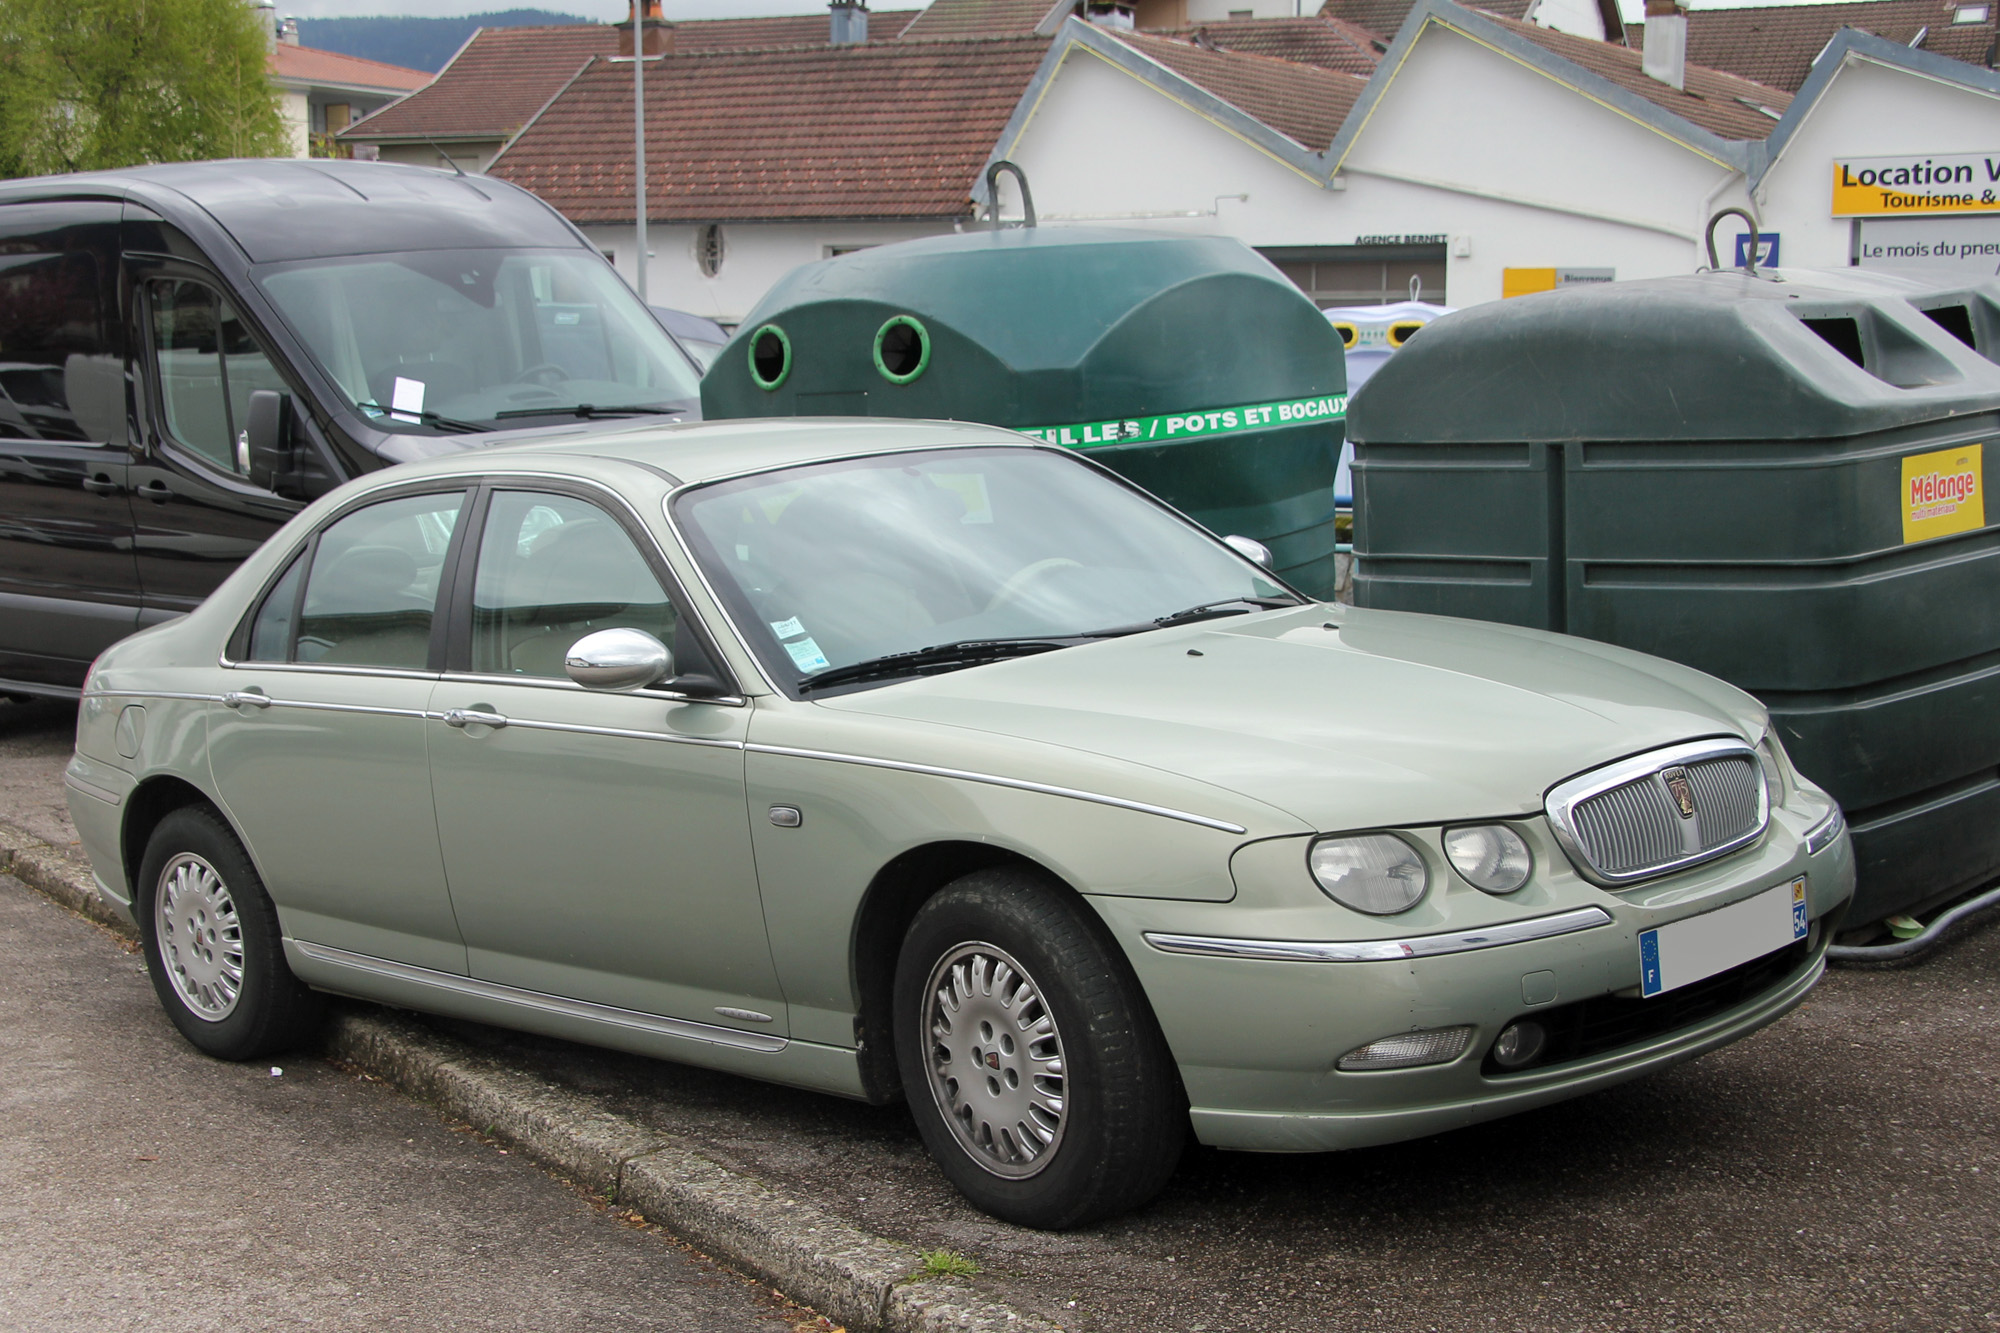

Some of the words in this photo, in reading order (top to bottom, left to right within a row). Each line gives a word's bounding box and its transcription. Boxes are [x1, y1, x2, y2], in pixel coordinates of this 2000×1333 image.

[1842, 160, 1972, 187] Location
[1880, 190, 1973, 209] Tourisme
[1980, 189, 1996, 205] &
[1355, 235, 1400, 245] AGENCE
[1404, 234, 1448, 244] BERNET
[1863, 243, 1882, 258] Le
[1887, 241, 1929, 257] mois
[1933, 241, 1956, 257] du
[1149, 419, 1159, 438] /
[1167, 411, 1238, 434] POTS
[1245, 406, 1272, 425] ET
[1279, 396, 1349, 421] BOCAUX
[1911, 473, 1974, 505] Mélange
[1911, 507, 1926, 520] multi
[1665, 769, 1684, 779] ROVER
[1794, 909, 1806, 932] 54
[1647, 969, 1654, 984] F
